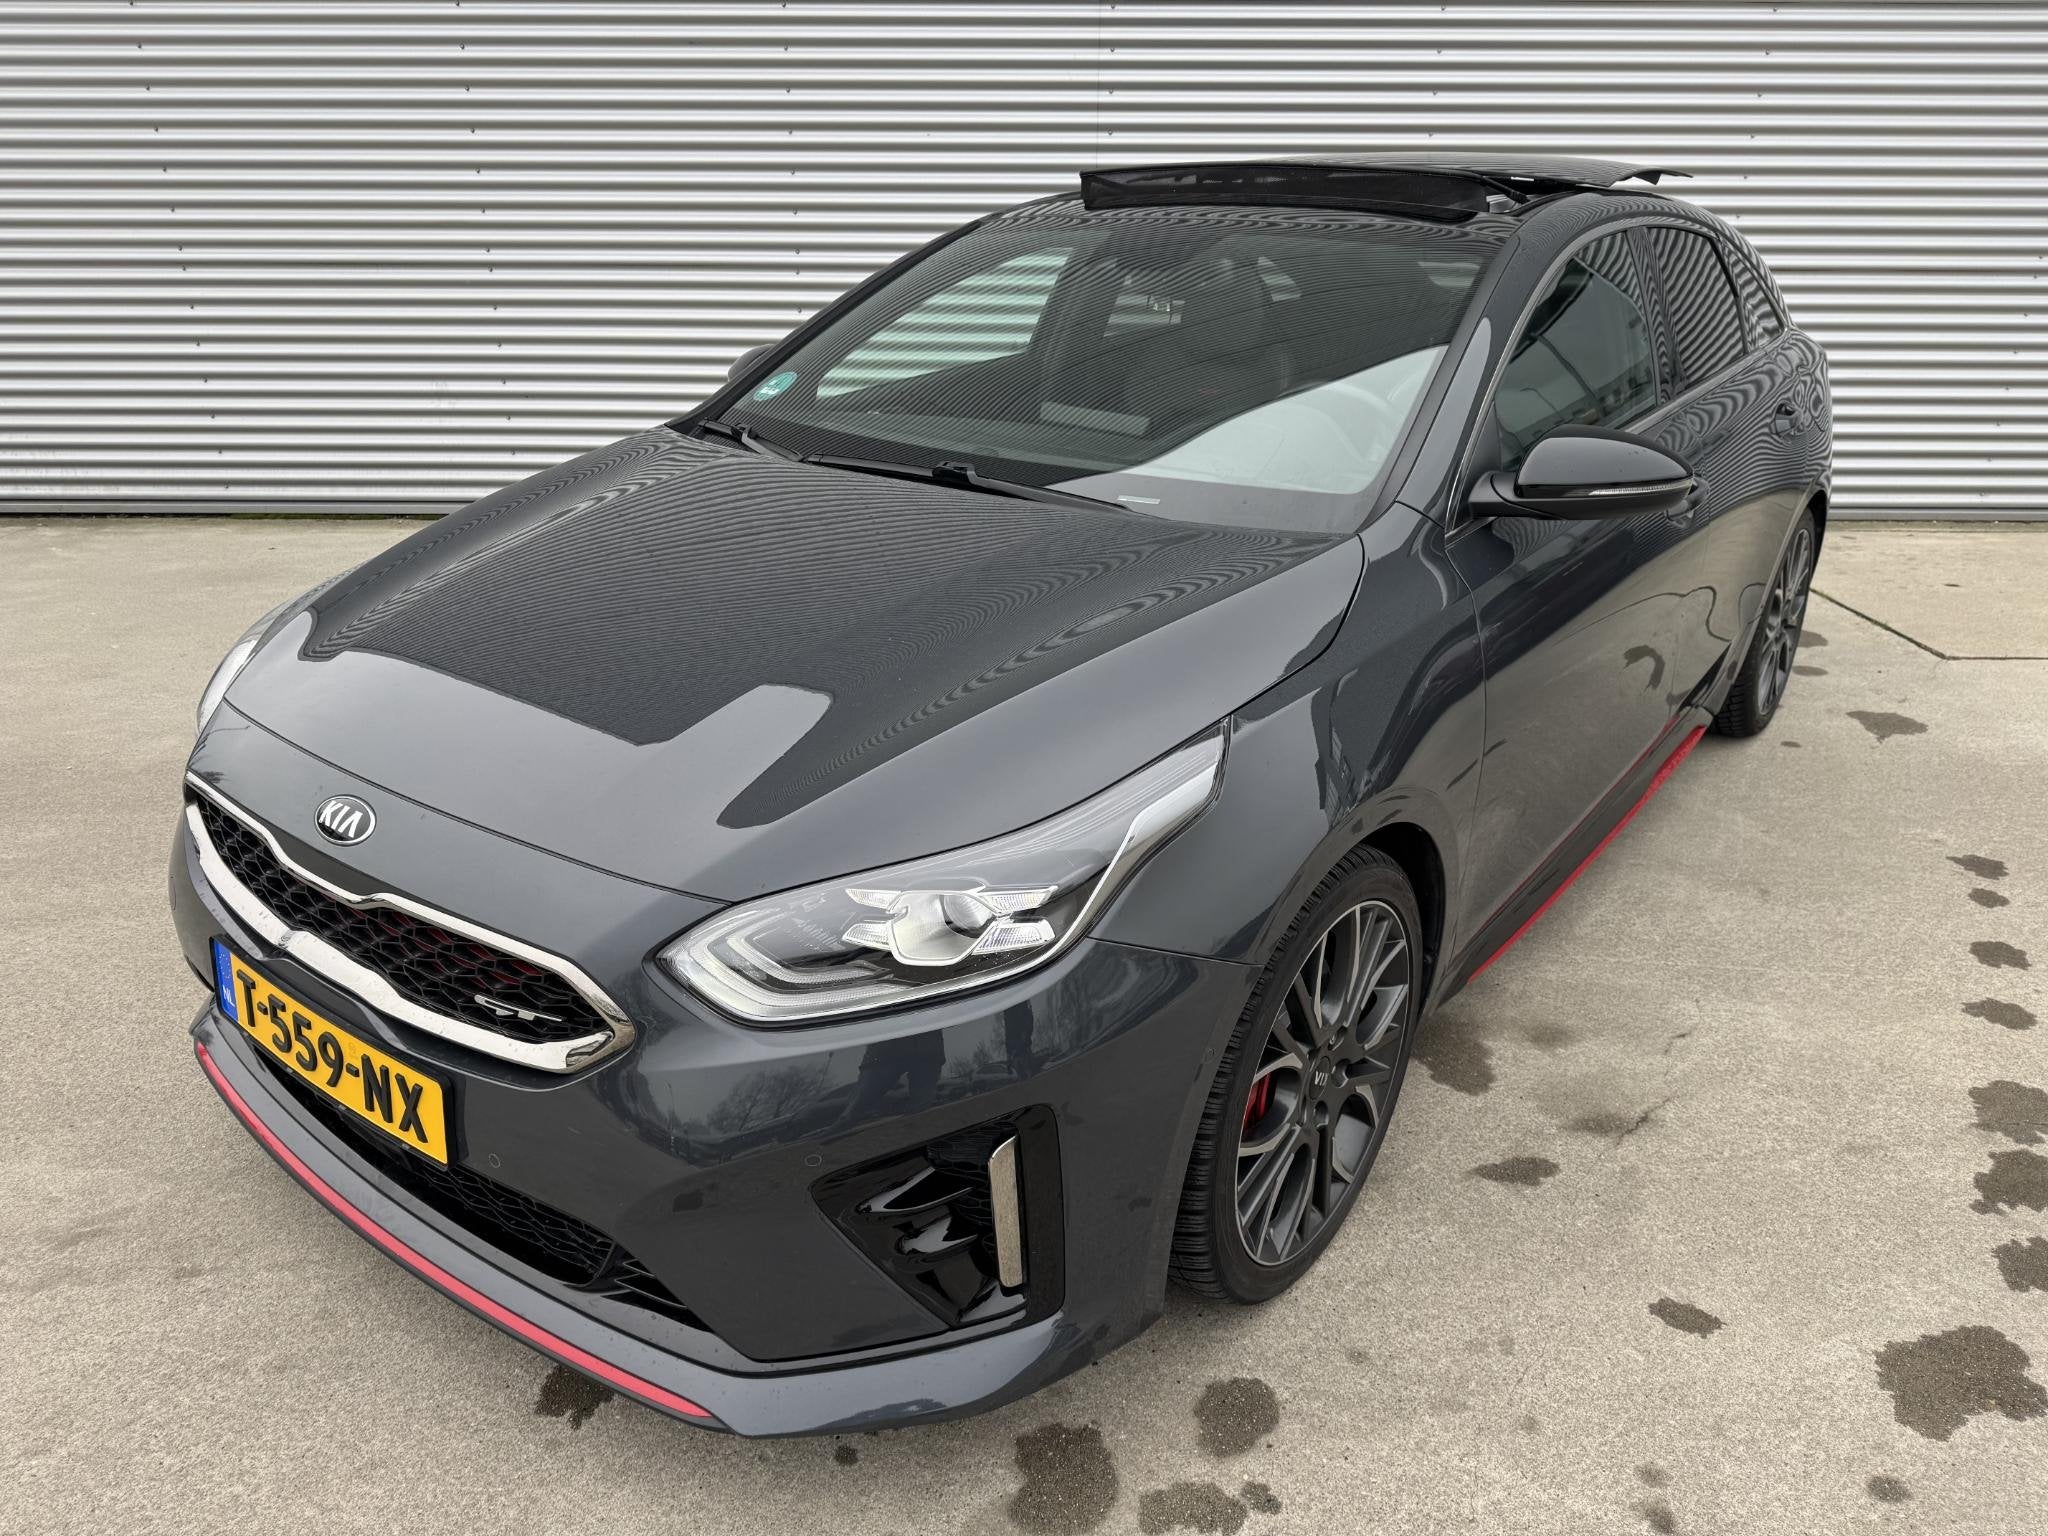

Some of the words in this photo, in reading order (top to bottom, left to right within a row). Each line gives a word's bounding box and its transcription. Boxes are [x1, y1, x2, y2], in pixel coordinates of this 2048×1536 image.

[319, 800, 363, 838] KIA
[222, 985, 235, 1007] NL
[237, 969, 428, 1143] T-559-NX
